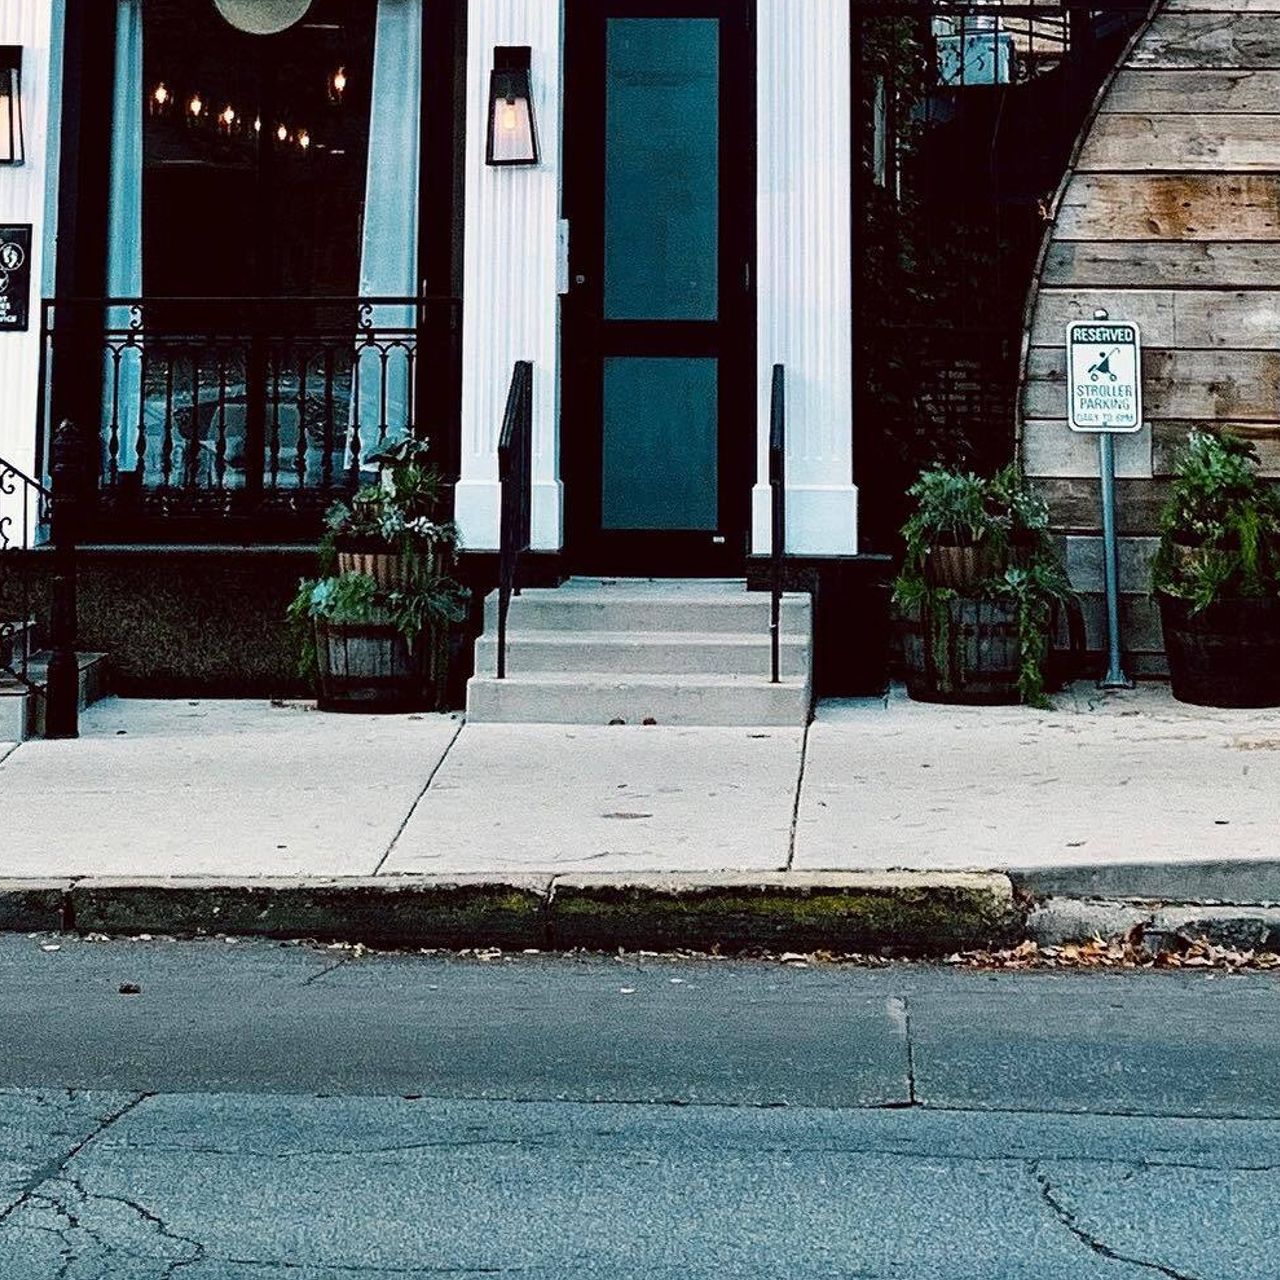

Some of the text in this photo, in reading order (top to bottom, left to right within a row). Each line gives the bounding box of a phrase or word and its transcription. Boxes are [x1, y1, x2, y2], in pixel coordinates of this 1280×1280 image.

[1073, 328, 1133, 342] RESERVED
[1076, 384, 1133, 398] STROLLER
[1079, 397, 1130, 410] PARKING
